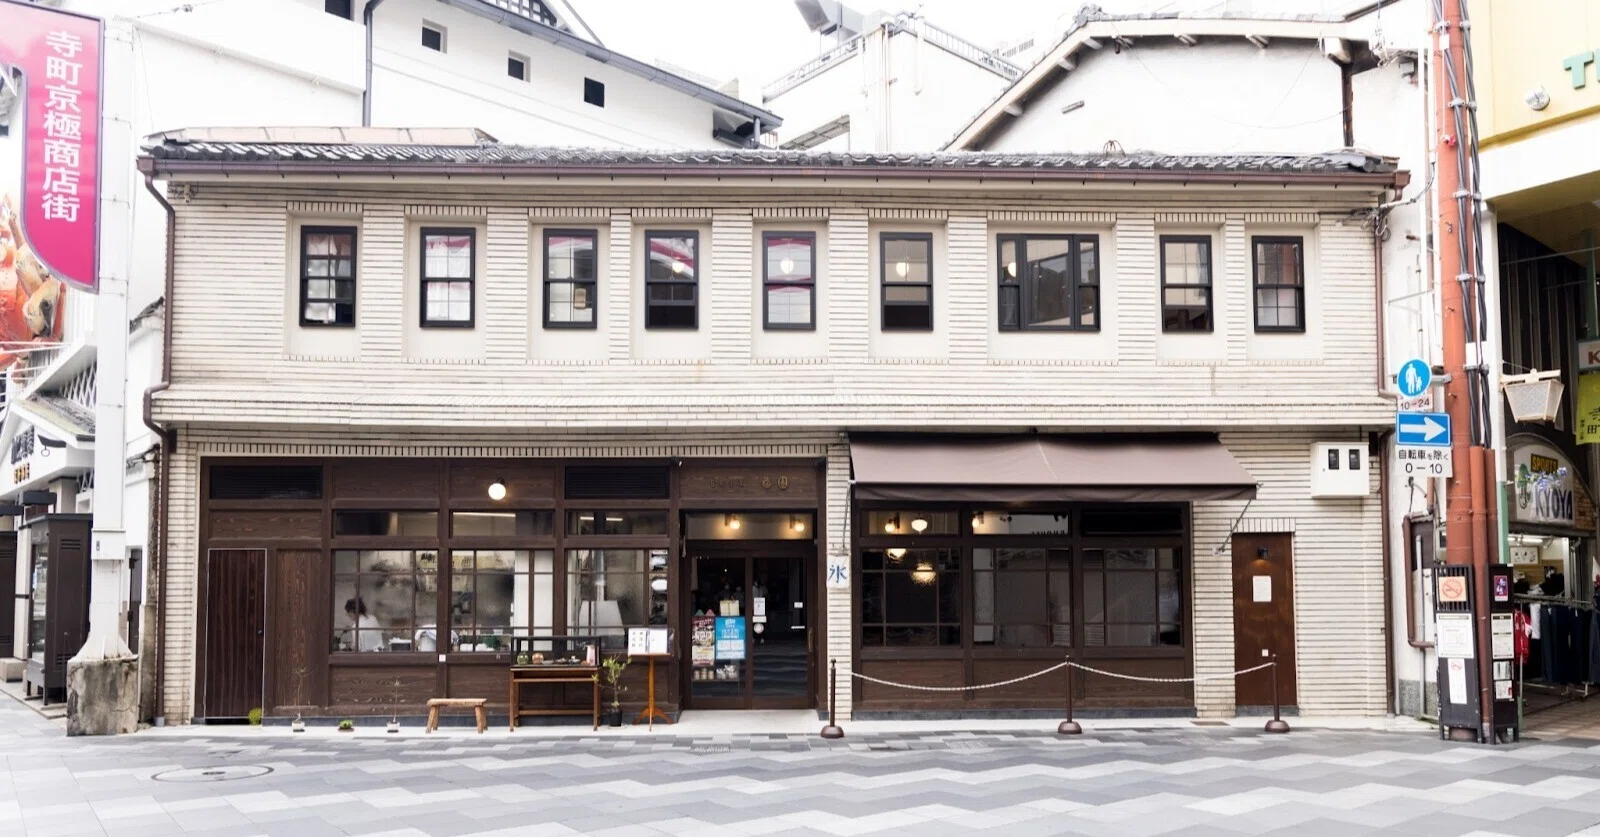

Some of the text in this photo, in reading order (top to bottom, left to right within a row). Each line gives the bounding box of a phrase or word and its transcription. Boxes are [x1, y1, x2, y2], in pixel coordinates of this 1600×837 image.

[42, 31, 83, 222] 寺町京極商店街
[1399, 449, 1449, 460] 自転車を除く
[828, 564, 848, 584] 氷
